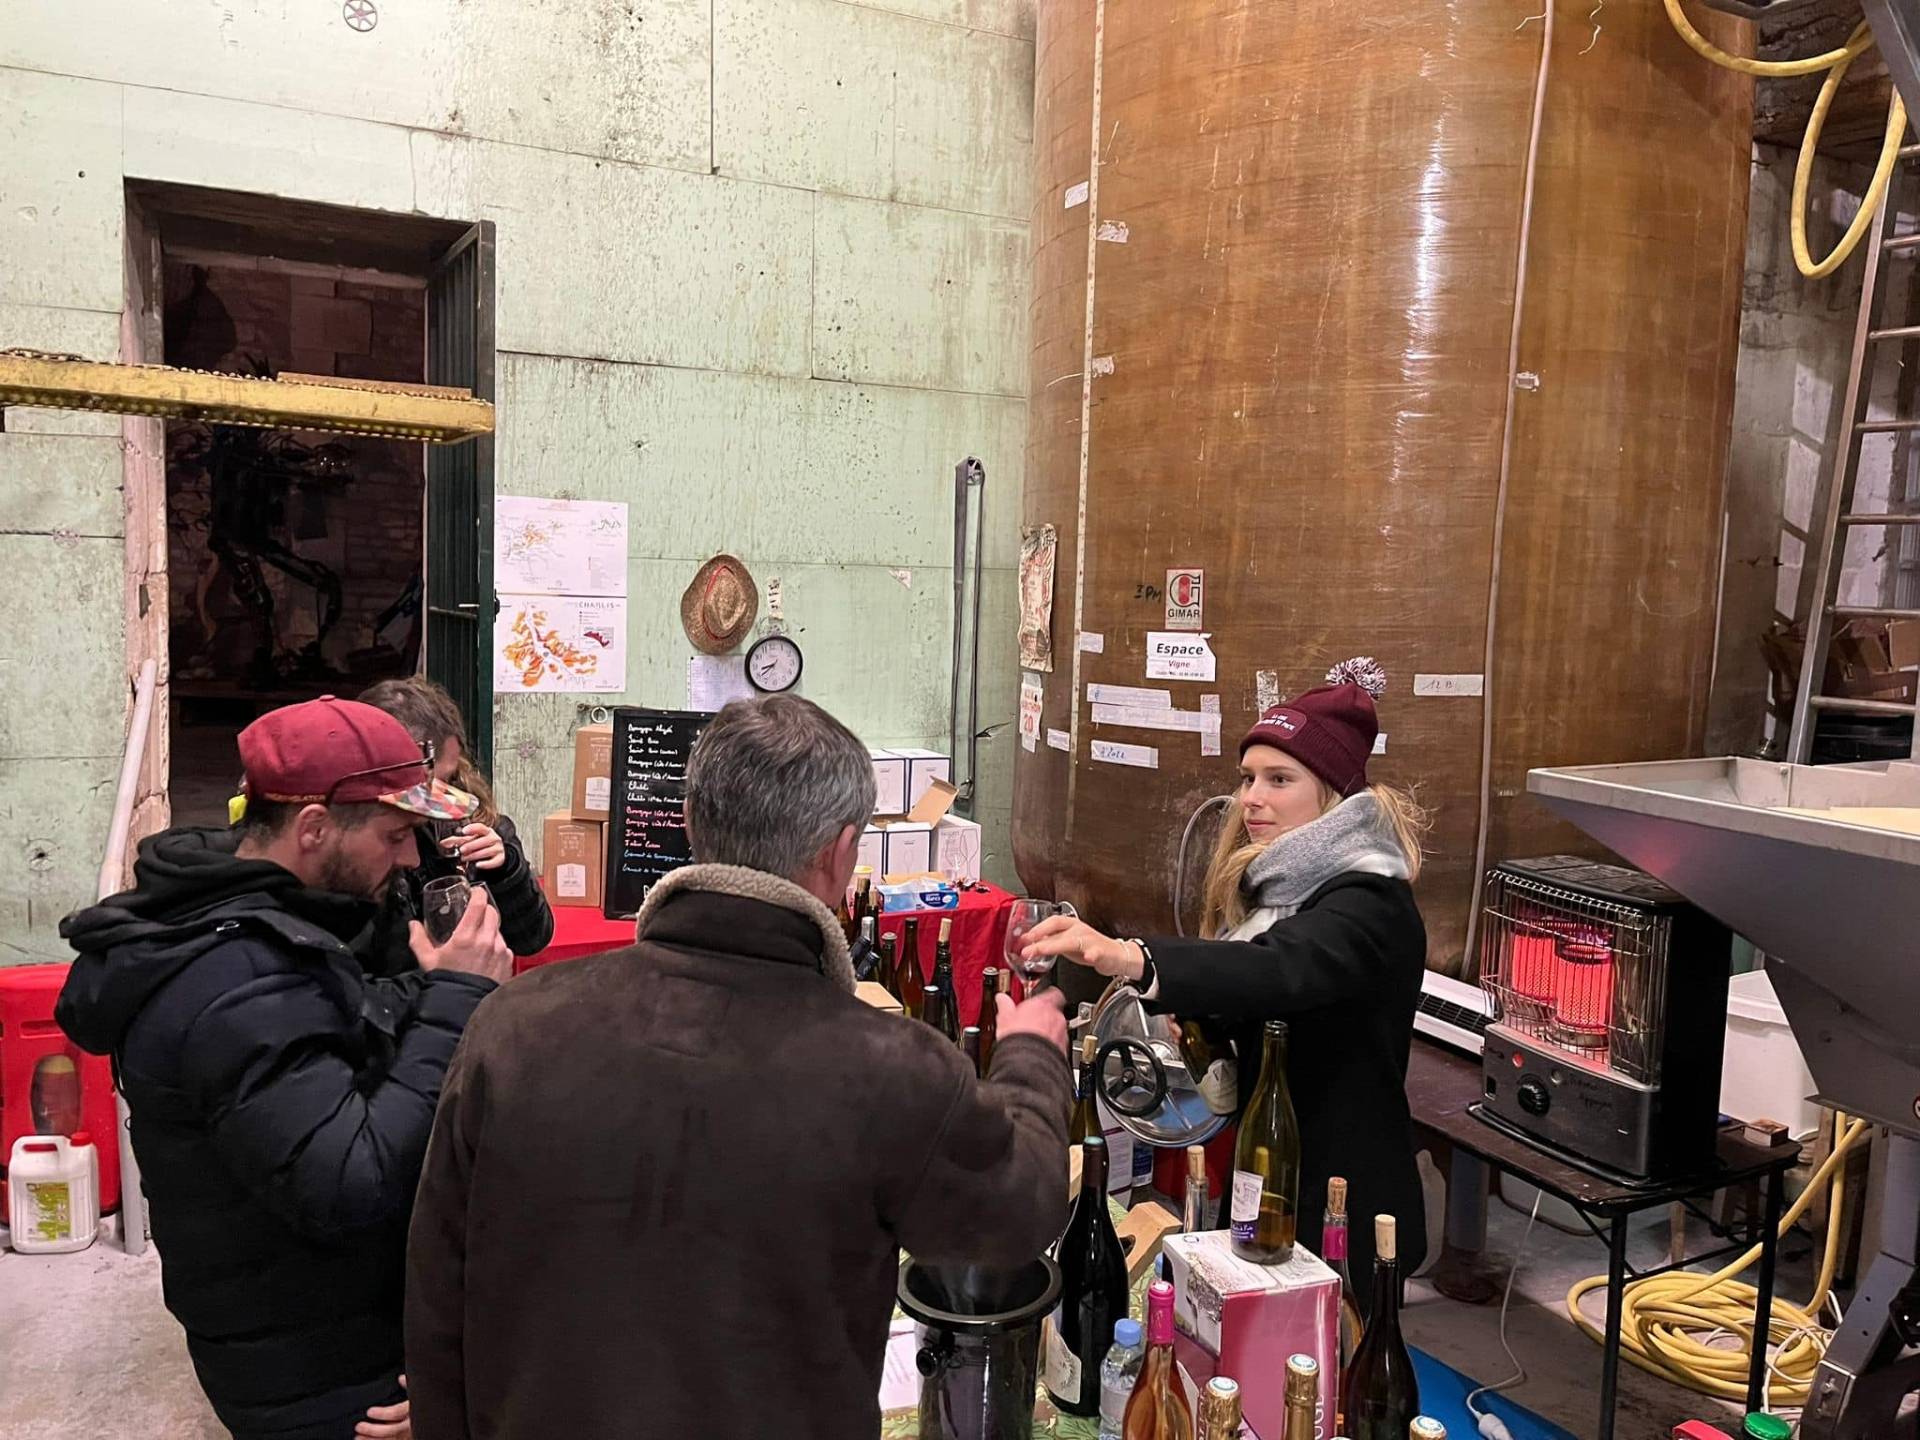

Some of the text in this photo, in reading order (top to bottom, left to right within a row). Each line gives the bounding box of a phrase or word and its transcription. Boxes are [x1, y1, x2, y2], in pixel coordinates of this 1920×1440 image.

[1168, 608, 1201, 618] GIMAR
[1156, 643, 1204, 656] Espace
[1168, 660, 1191, 669] Vigne
